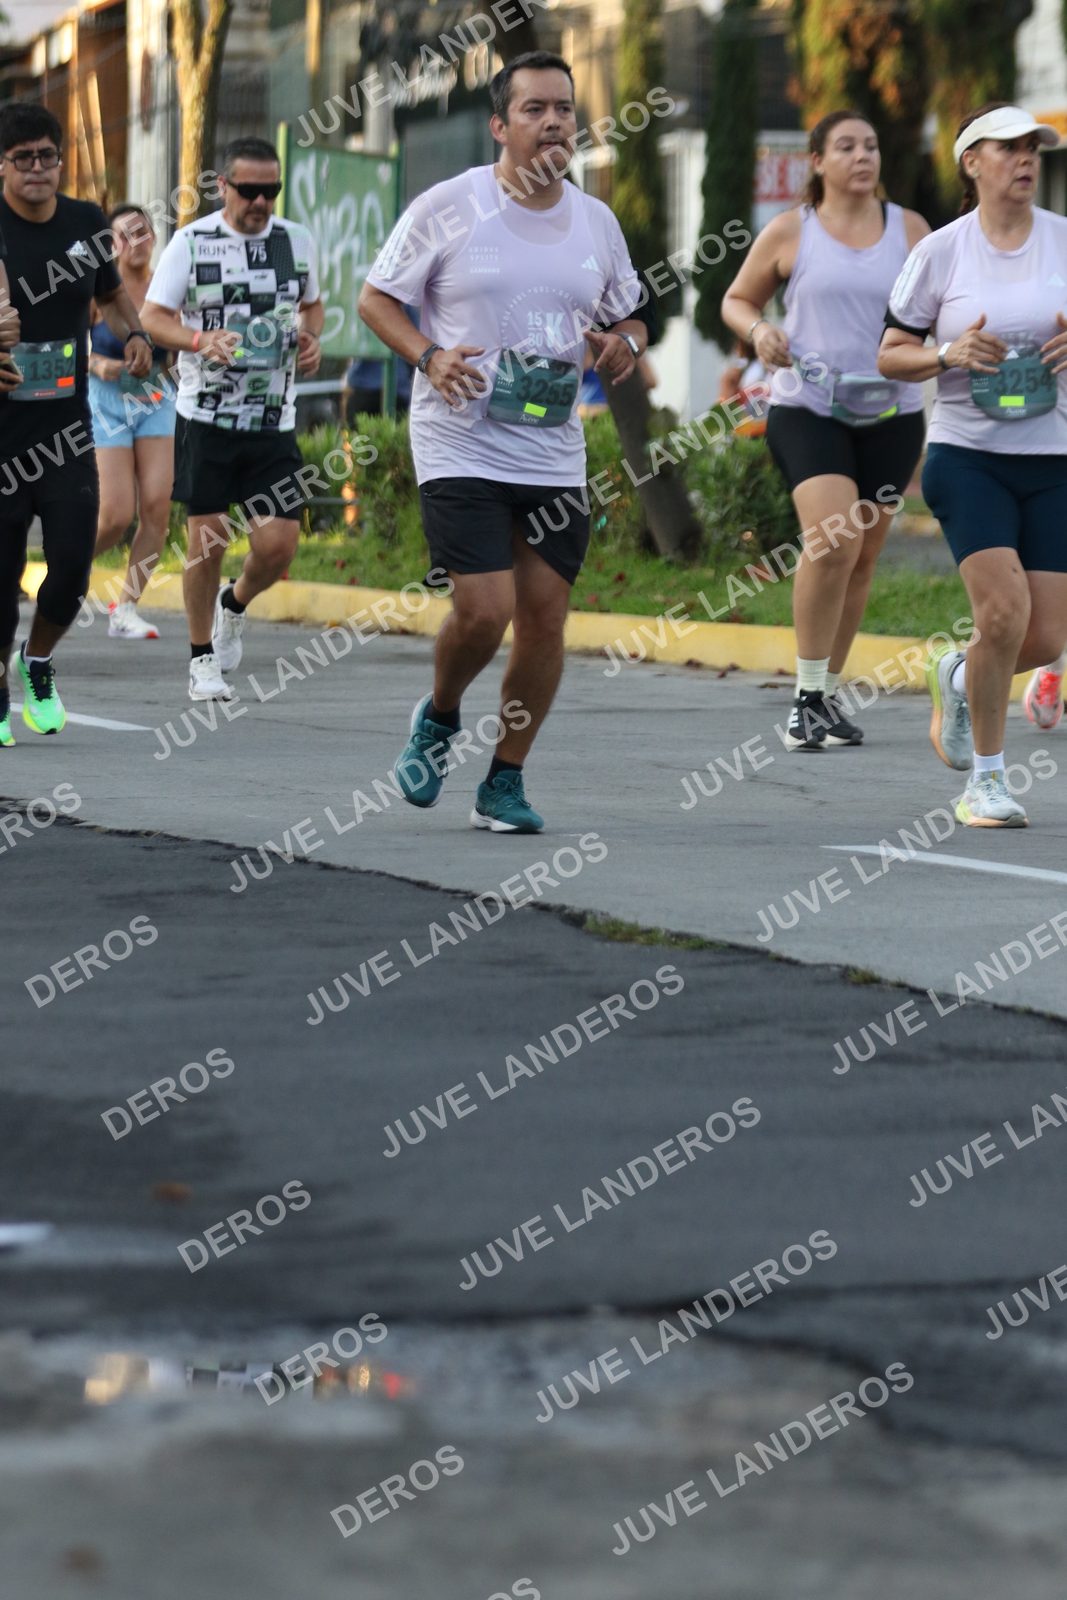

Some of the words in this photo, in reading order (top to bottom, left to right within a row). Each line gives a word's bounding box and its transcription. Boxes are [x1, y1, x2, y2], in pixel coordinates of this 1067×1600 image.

[198, 245, 226, 256] RUN
[250, 246, 267, 263] 75
[528, 311, 543, 327] 15
[994, 366, 1055, 395] 3254
[517, 376, 574, 406] 3255
